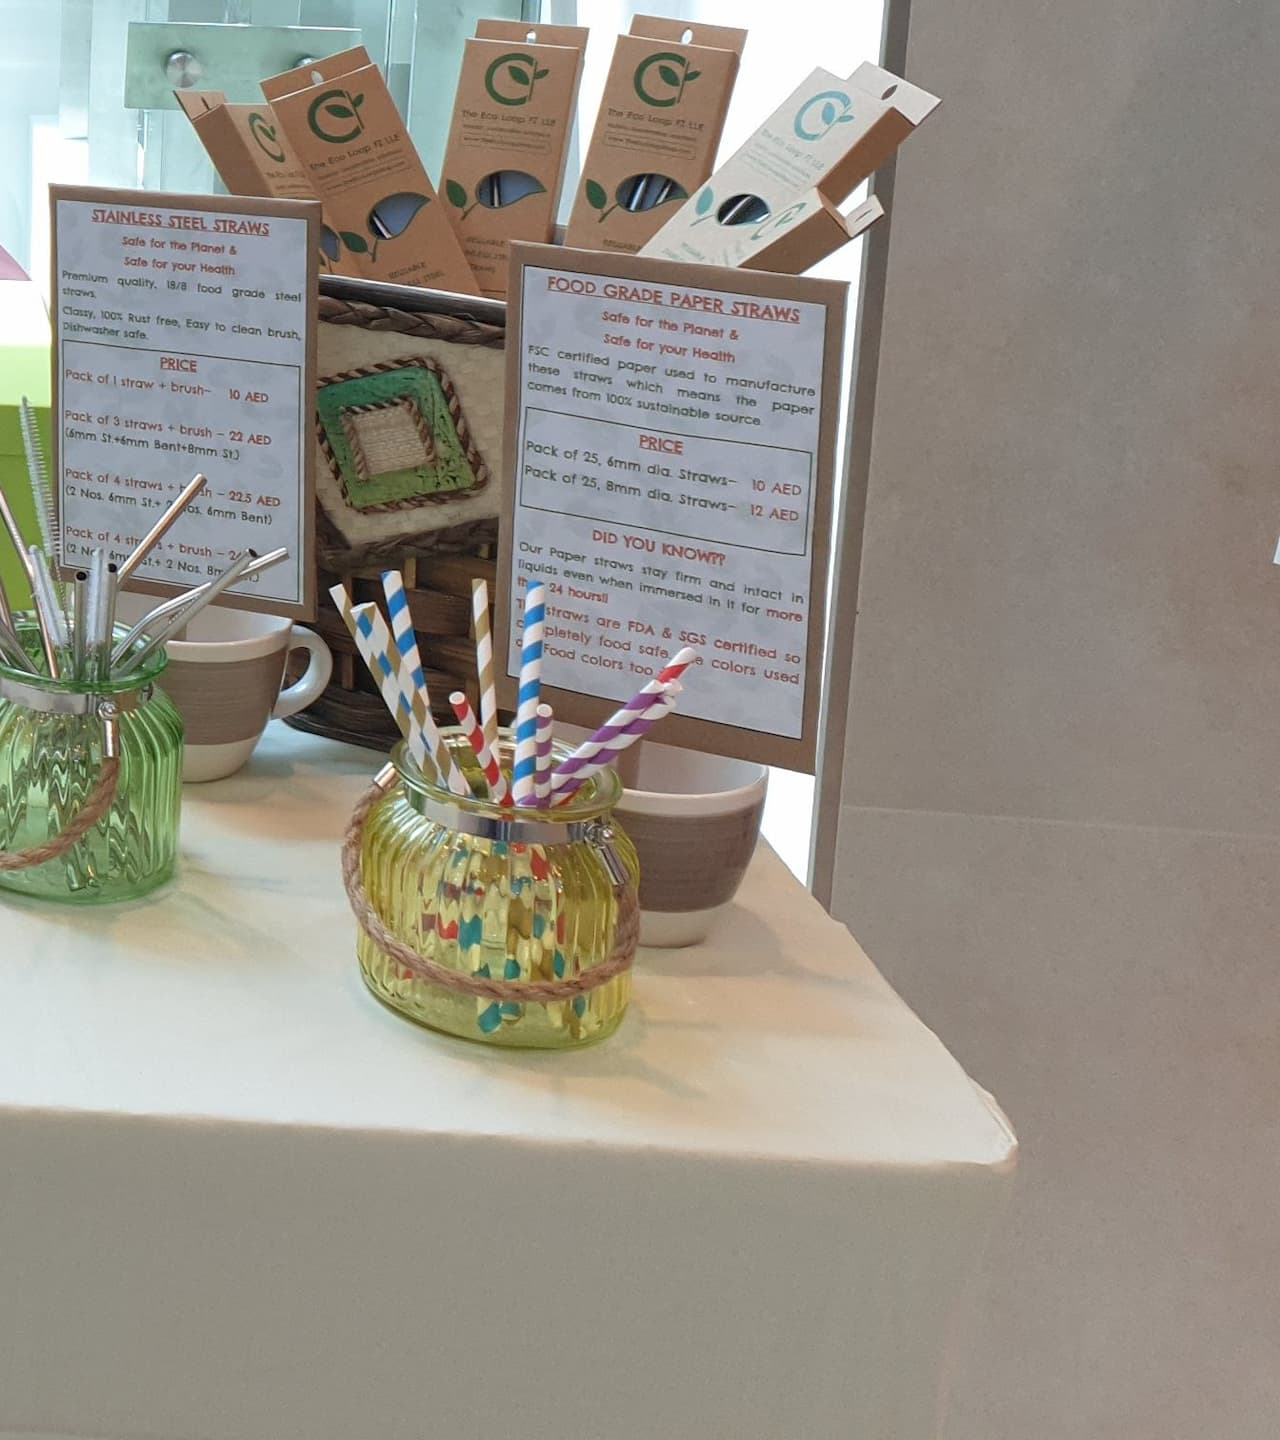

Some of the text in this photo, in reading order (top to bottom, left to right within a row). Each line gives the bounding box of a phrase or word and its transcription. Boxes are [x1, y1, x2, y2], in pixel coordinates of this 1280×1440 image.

[462, 110, 477, 120] The
[480, 111, 498, 121] Eco
[502, 114, 526, 125] Loop
[92, 209, 269, 236] STAINLESS STEEL STRAWS
[62, 270, 108, 284] Premium
[167, 280, 187, 291] 18/8
[197, 283, 222, 295] food
[232, 288, 265, 300] grade
[276, 291, 301, 303] steel
[547, 277, 800, 323] FOOD GRADE PAPER STRAWS
[602, 311, 739, 341] Safe for the Planet &
[160, 357, 197, 373] PRICE
[528, 345, 816, 397] FSC certified paper used to manufacture
[66, 369, 93, 383] Pack
[98, 374, 111, 385] of
[121, 378, 153, 390] straw
[229, 389, 240, 399] 10
[245, 391, 269, 404] AED
[639, 434, 683, 455] PRICE
[592, 529, 726, 565] DID YOU KNOW??
